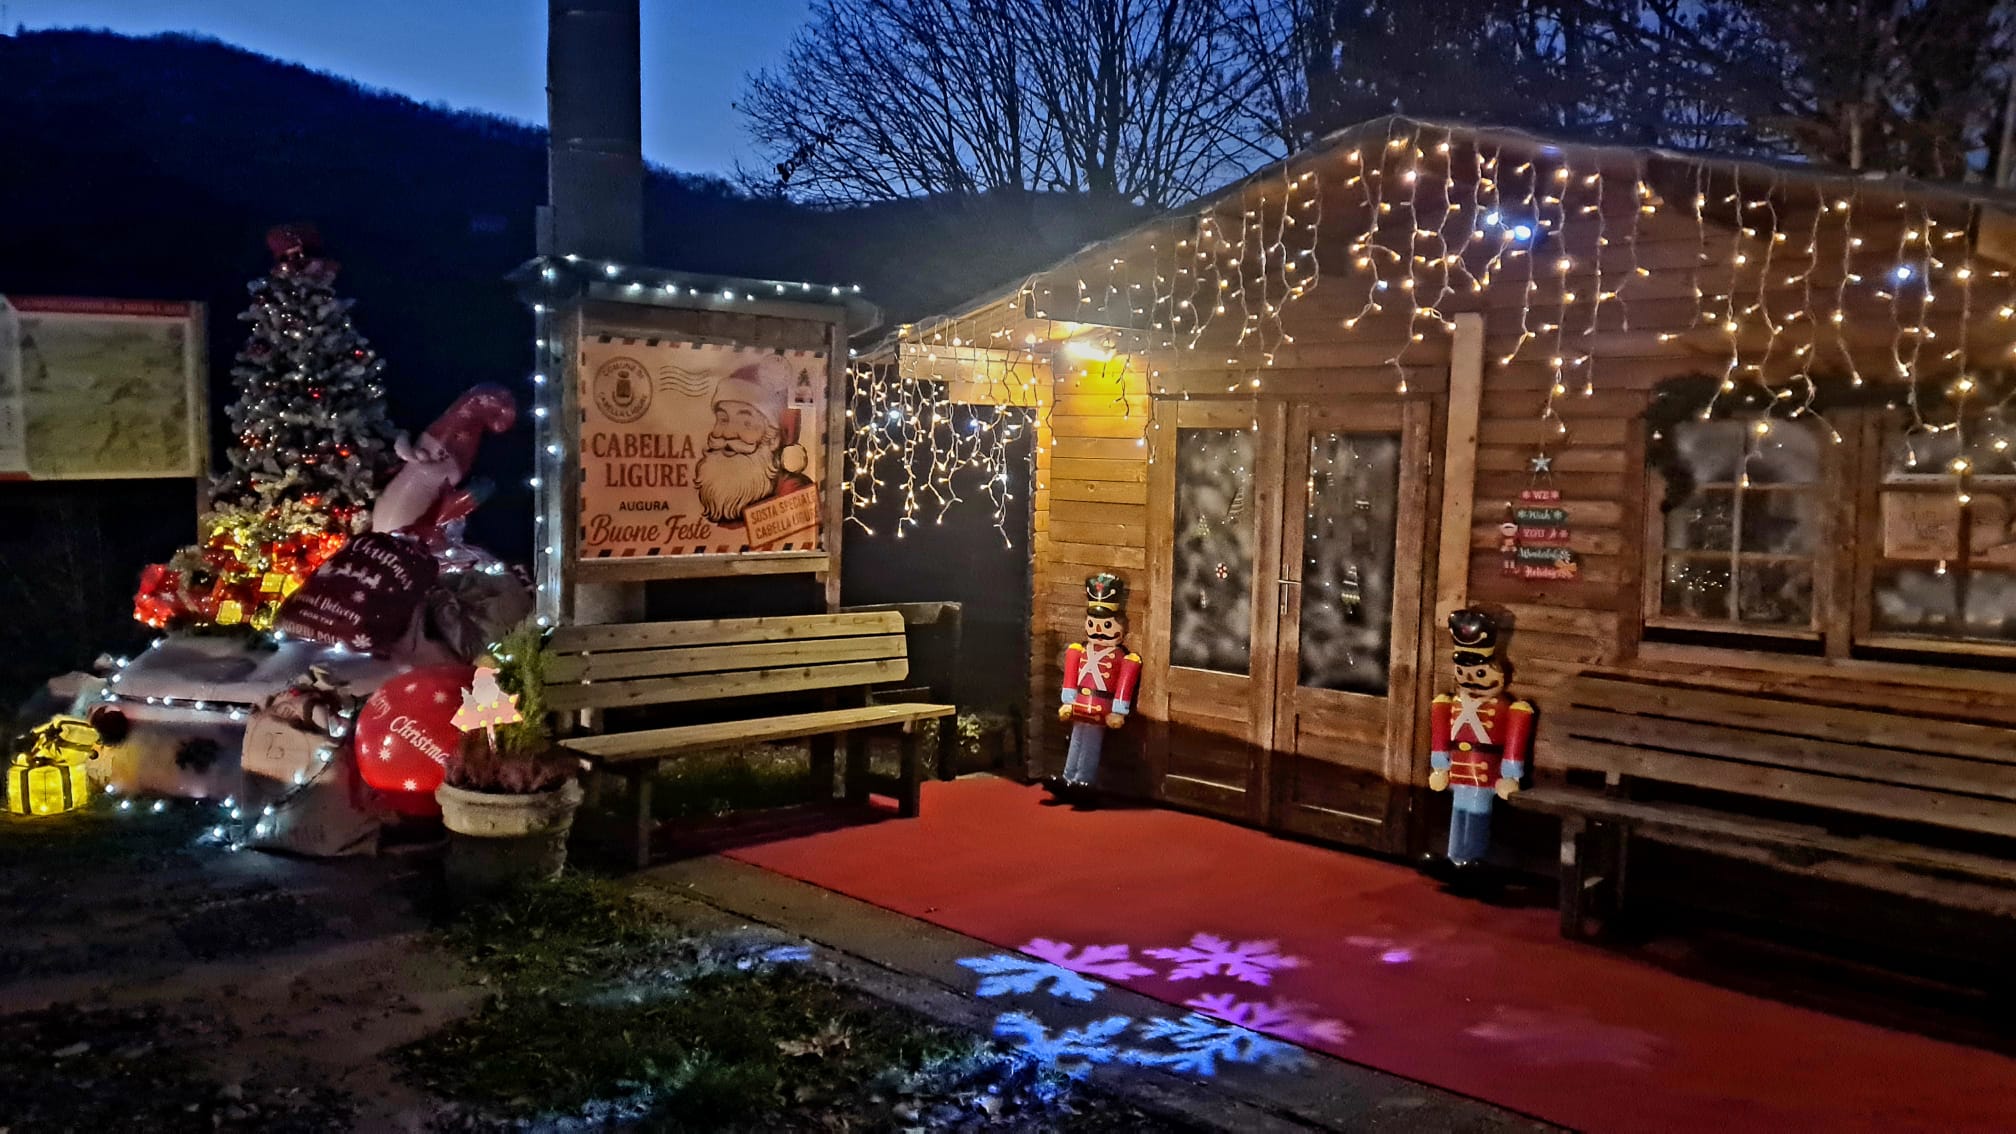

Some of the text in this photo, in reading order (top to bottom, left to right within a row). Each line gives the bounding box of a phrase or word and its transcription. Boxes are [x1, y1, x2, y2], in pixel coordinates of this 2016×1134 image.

[592, 433, 696, 459] CABELLA
[605, 463, 689, 488] LIGURE
[619, 500, 670, 511] AUGURA
[751, 505, 778, 525] SOSTA
[587, 514, 712, 546] Buone Feste
[755, 517, 792, 540] CABELLA
[352, 536, 414, 591] Christmas
[320, 597, 362, 626] Delivery
[390, 715, 451, 765] Christma
